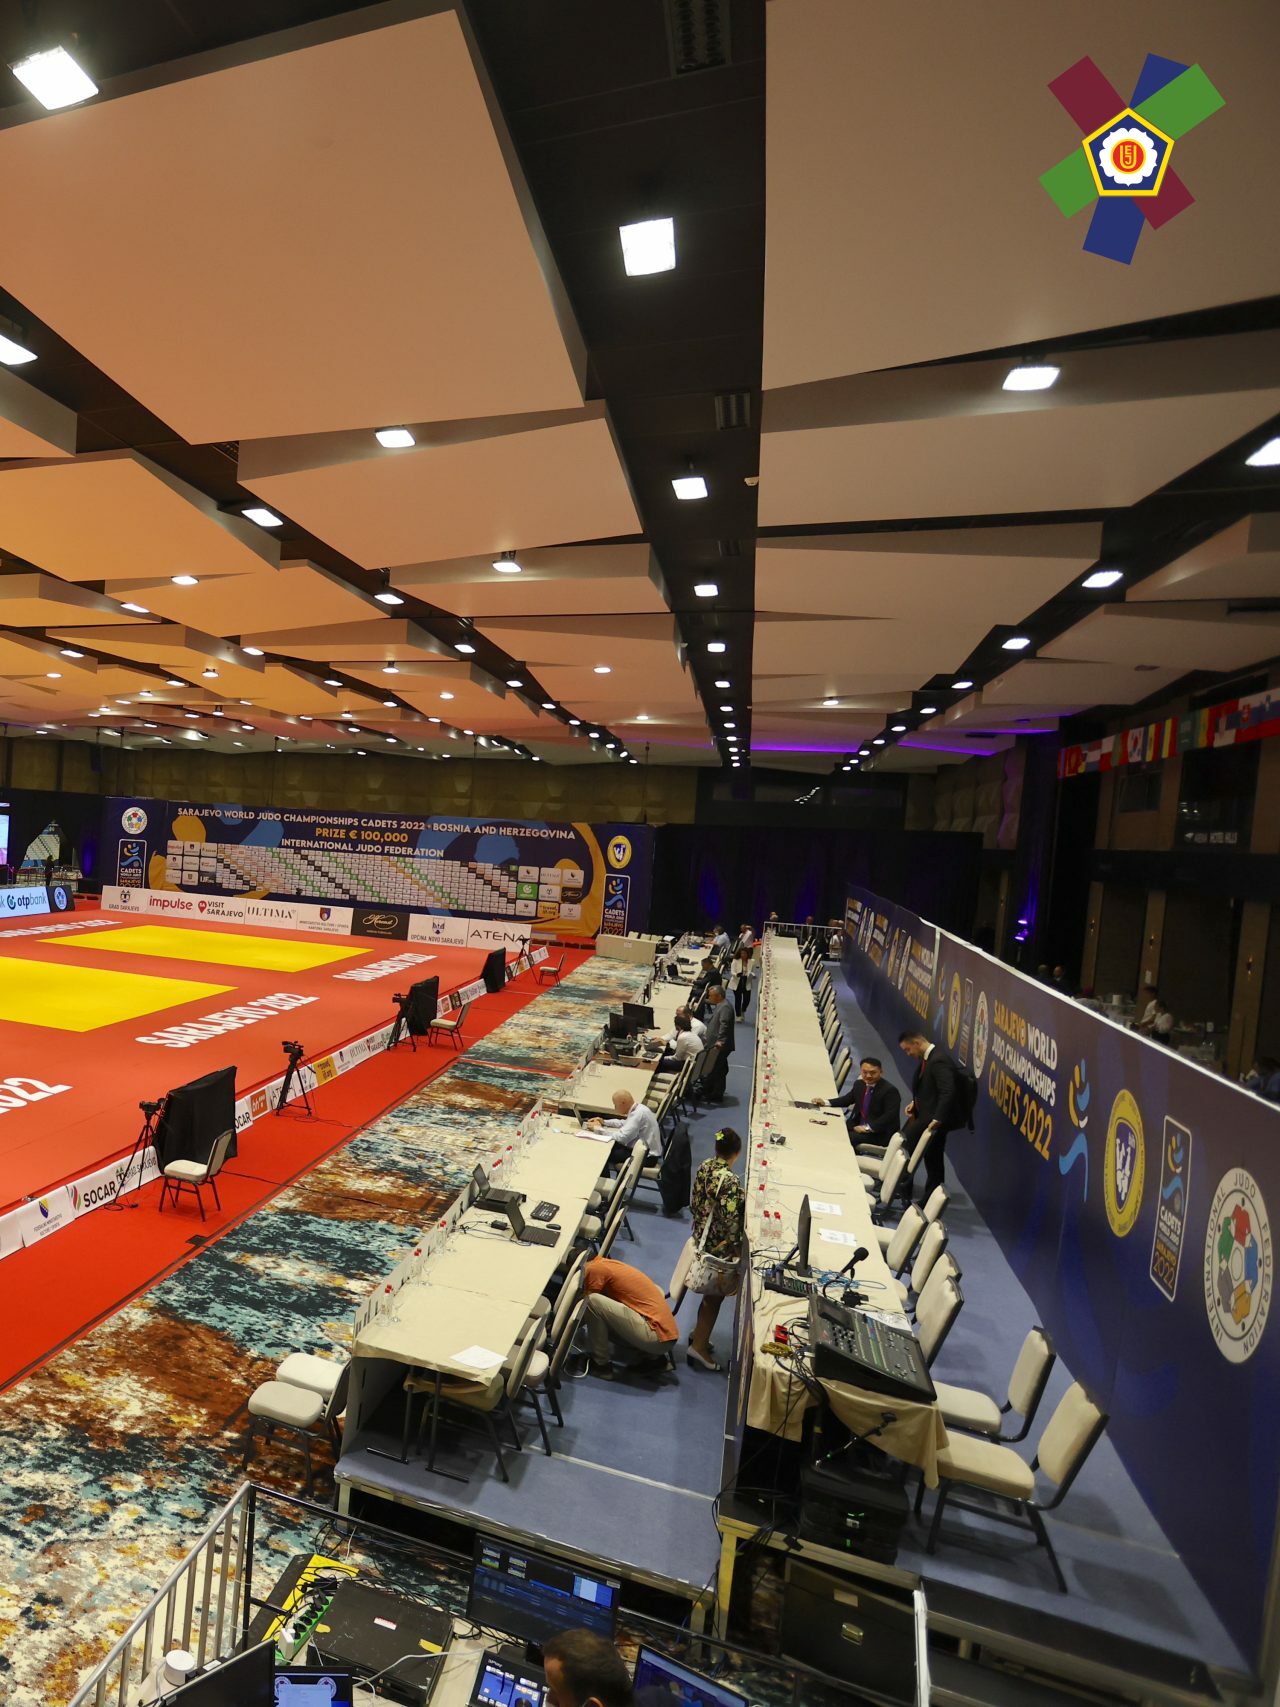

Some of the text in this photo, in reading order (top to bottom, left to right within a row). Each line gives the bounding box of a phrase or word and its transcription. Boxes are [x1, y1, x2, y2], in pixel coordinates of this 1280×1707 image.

[177, 807, 576, 840] SARAJEVO WORLD JUDO CHAMPIONSHIPS CADETS 2022 BOSNIA AND HERZEGOVINA
[315, 827, 408, 843] PRIZE € 100,000
[281, 838, 444, 858] INTERNATIONAL JUDO FEDERATION
[17, 892, 47, 910] otpbank
[149, 895, 193, 911] impulse
[208, 900, 225, 909] VISIT
[604, 908, 625, 917] CADETS
[206, 908, 244, 918] SARAJEVO
[247, 906, 293, 920] ULTIMA
[440, 937, 465, 946] SARAJEVO
[470, 929, 525, 943] ATENA
[135, 992, 320, 1049] SARAJEVO 2022
[993, 1000, 1026, 1047] SARAJEVO
[1027, 1022, 1058, 1071] WORLD
[991, 1031, 1005, 1061] JUDO
[1005, 1043, 1057, 1107] CHAMPIONSHIPS
[235, 1111, 251, 1130] OCAR
[988, 1060, 1053, 1161] CADETS 2022
[83, 1180, 117, 1208] SOCAR
[1233, 1172, 1256, 1199] JUDO
[1160, 1205, 1182, 1236] CADETS
[1153, 1250, 1175, 1289] 2022
[1206, 1185, 1226, 1343] INTERNATIONAL
[1243, 1222, 1272, 1355] FEDERATION
